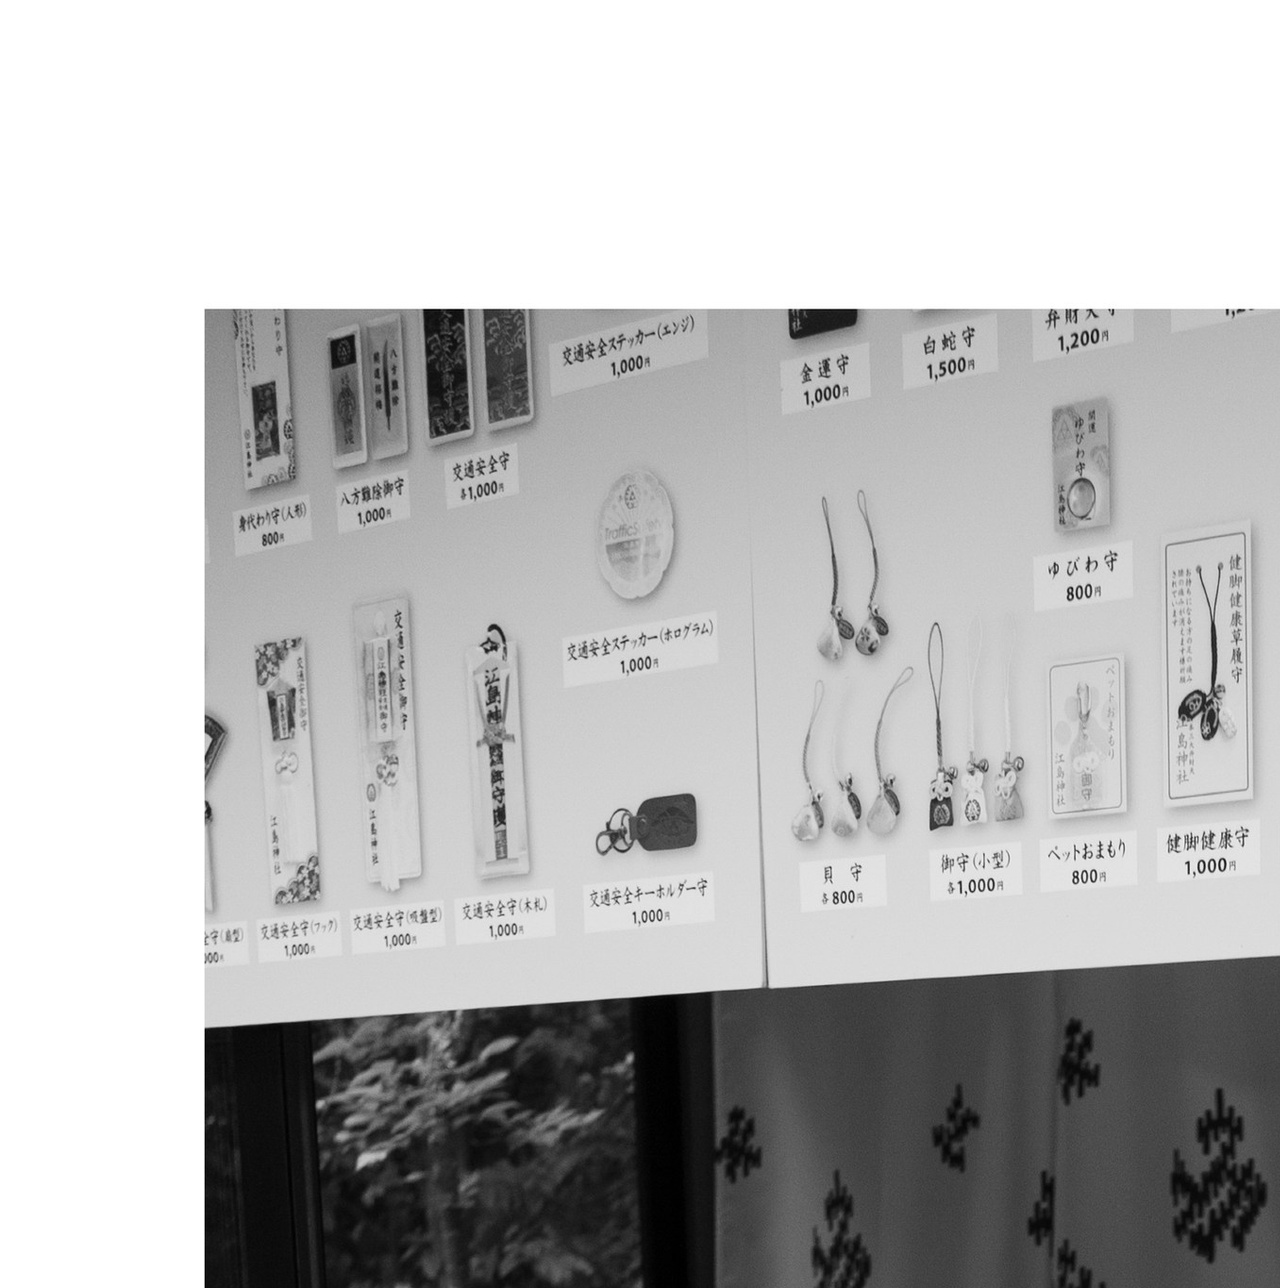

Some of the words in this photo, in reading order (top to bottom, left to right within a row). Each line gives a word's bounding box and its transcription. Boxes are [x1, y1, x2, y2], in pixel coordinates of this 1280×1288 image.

[562, 314, 695, 367] 交通安全ステッカー(エンジ)
[923, 326, 975, 355] 白蛇守
[1058, 328, 1109, 354] 1,200円
[611, 355, 650, 378] 1,000円
[801, 354, 849, 384] 金運守
[927, 357, 975, 382] 1,500円
[804, 384, 849, 408] 1,000円
[453, 451, 510, 482] 交通安全守
[340, 477, 404, 506] 八方難除御守
[358, 507, 392, 527] 1,000円
[261, 532, 284, 547] 800円
[1047, 550, 1119, 579] ゆびわ守
[1066, 583, 1102, 602] 800円
[566, 620, 714, 663] 交通安全ステッカー(ホログラム)
[620, 655, 659, 677] 1,000円
[1047, 838, 1128, 861] ペットおまもり
[1166, 826, 1250, 855] 健脚健康守
[940, 849, 1012, 874] 御守(小型)
[1184, 856, 1237, 876] 1,000円
[1071, 867, 1106, 886] 800円
[589, 878, 709, 909] 交通安全キーホルダー守
[461, 895, 548, 922] 交通安全守(木札)
[631, 907, 671, 927] 1,000円
[261, 918, 338, 941] 交通安全守(フック)
[384, 933, 417, 949] 1,000円
[488, 922, 524, 941] 1,000円
[284, 943, 316, 959] 1,000円
